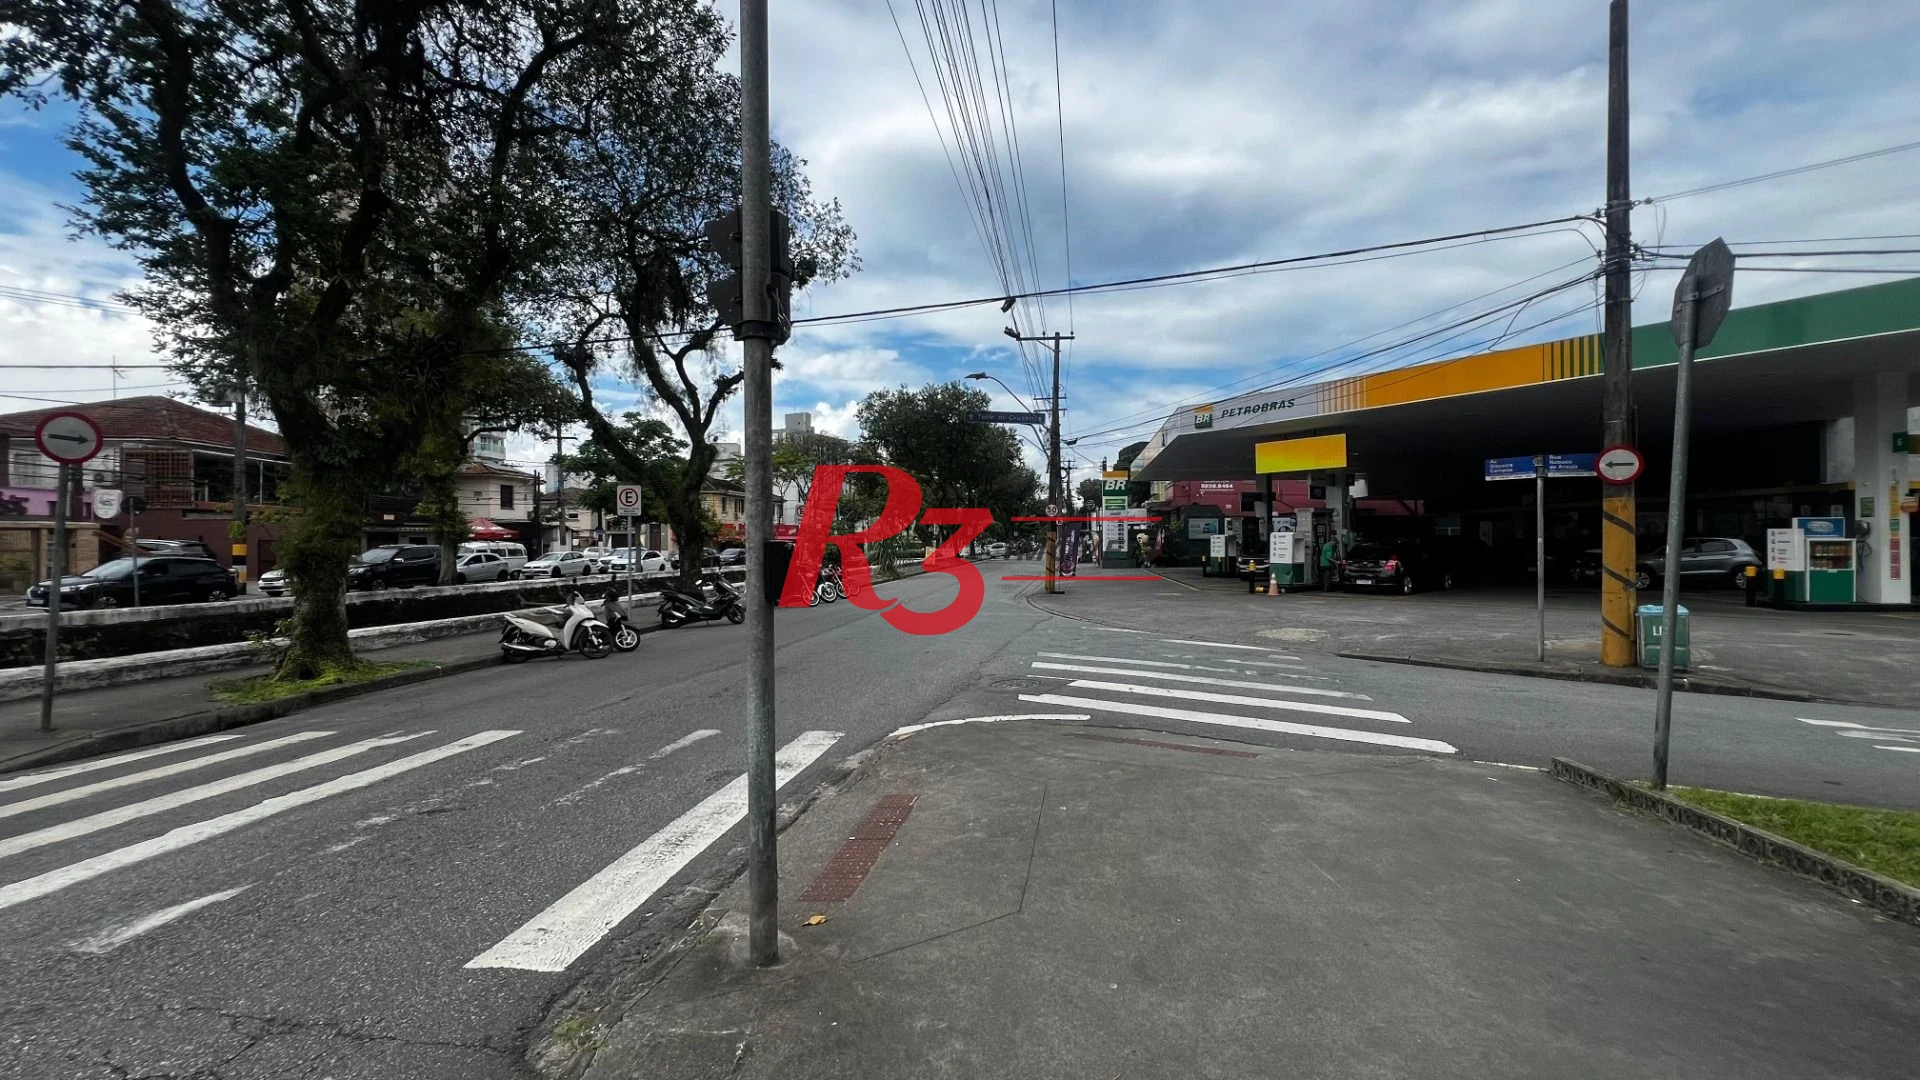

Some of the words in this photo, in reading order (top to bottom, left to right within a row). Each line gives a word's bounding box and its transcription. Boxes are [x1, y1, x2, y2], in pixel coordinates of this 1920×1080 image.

[1195, 414, 1210, 424] BR
[1221, 398, 1295, 419] PETROBRAS
[1104, 480, 1126, 490] BR
[626, 491, 633, 503] E
